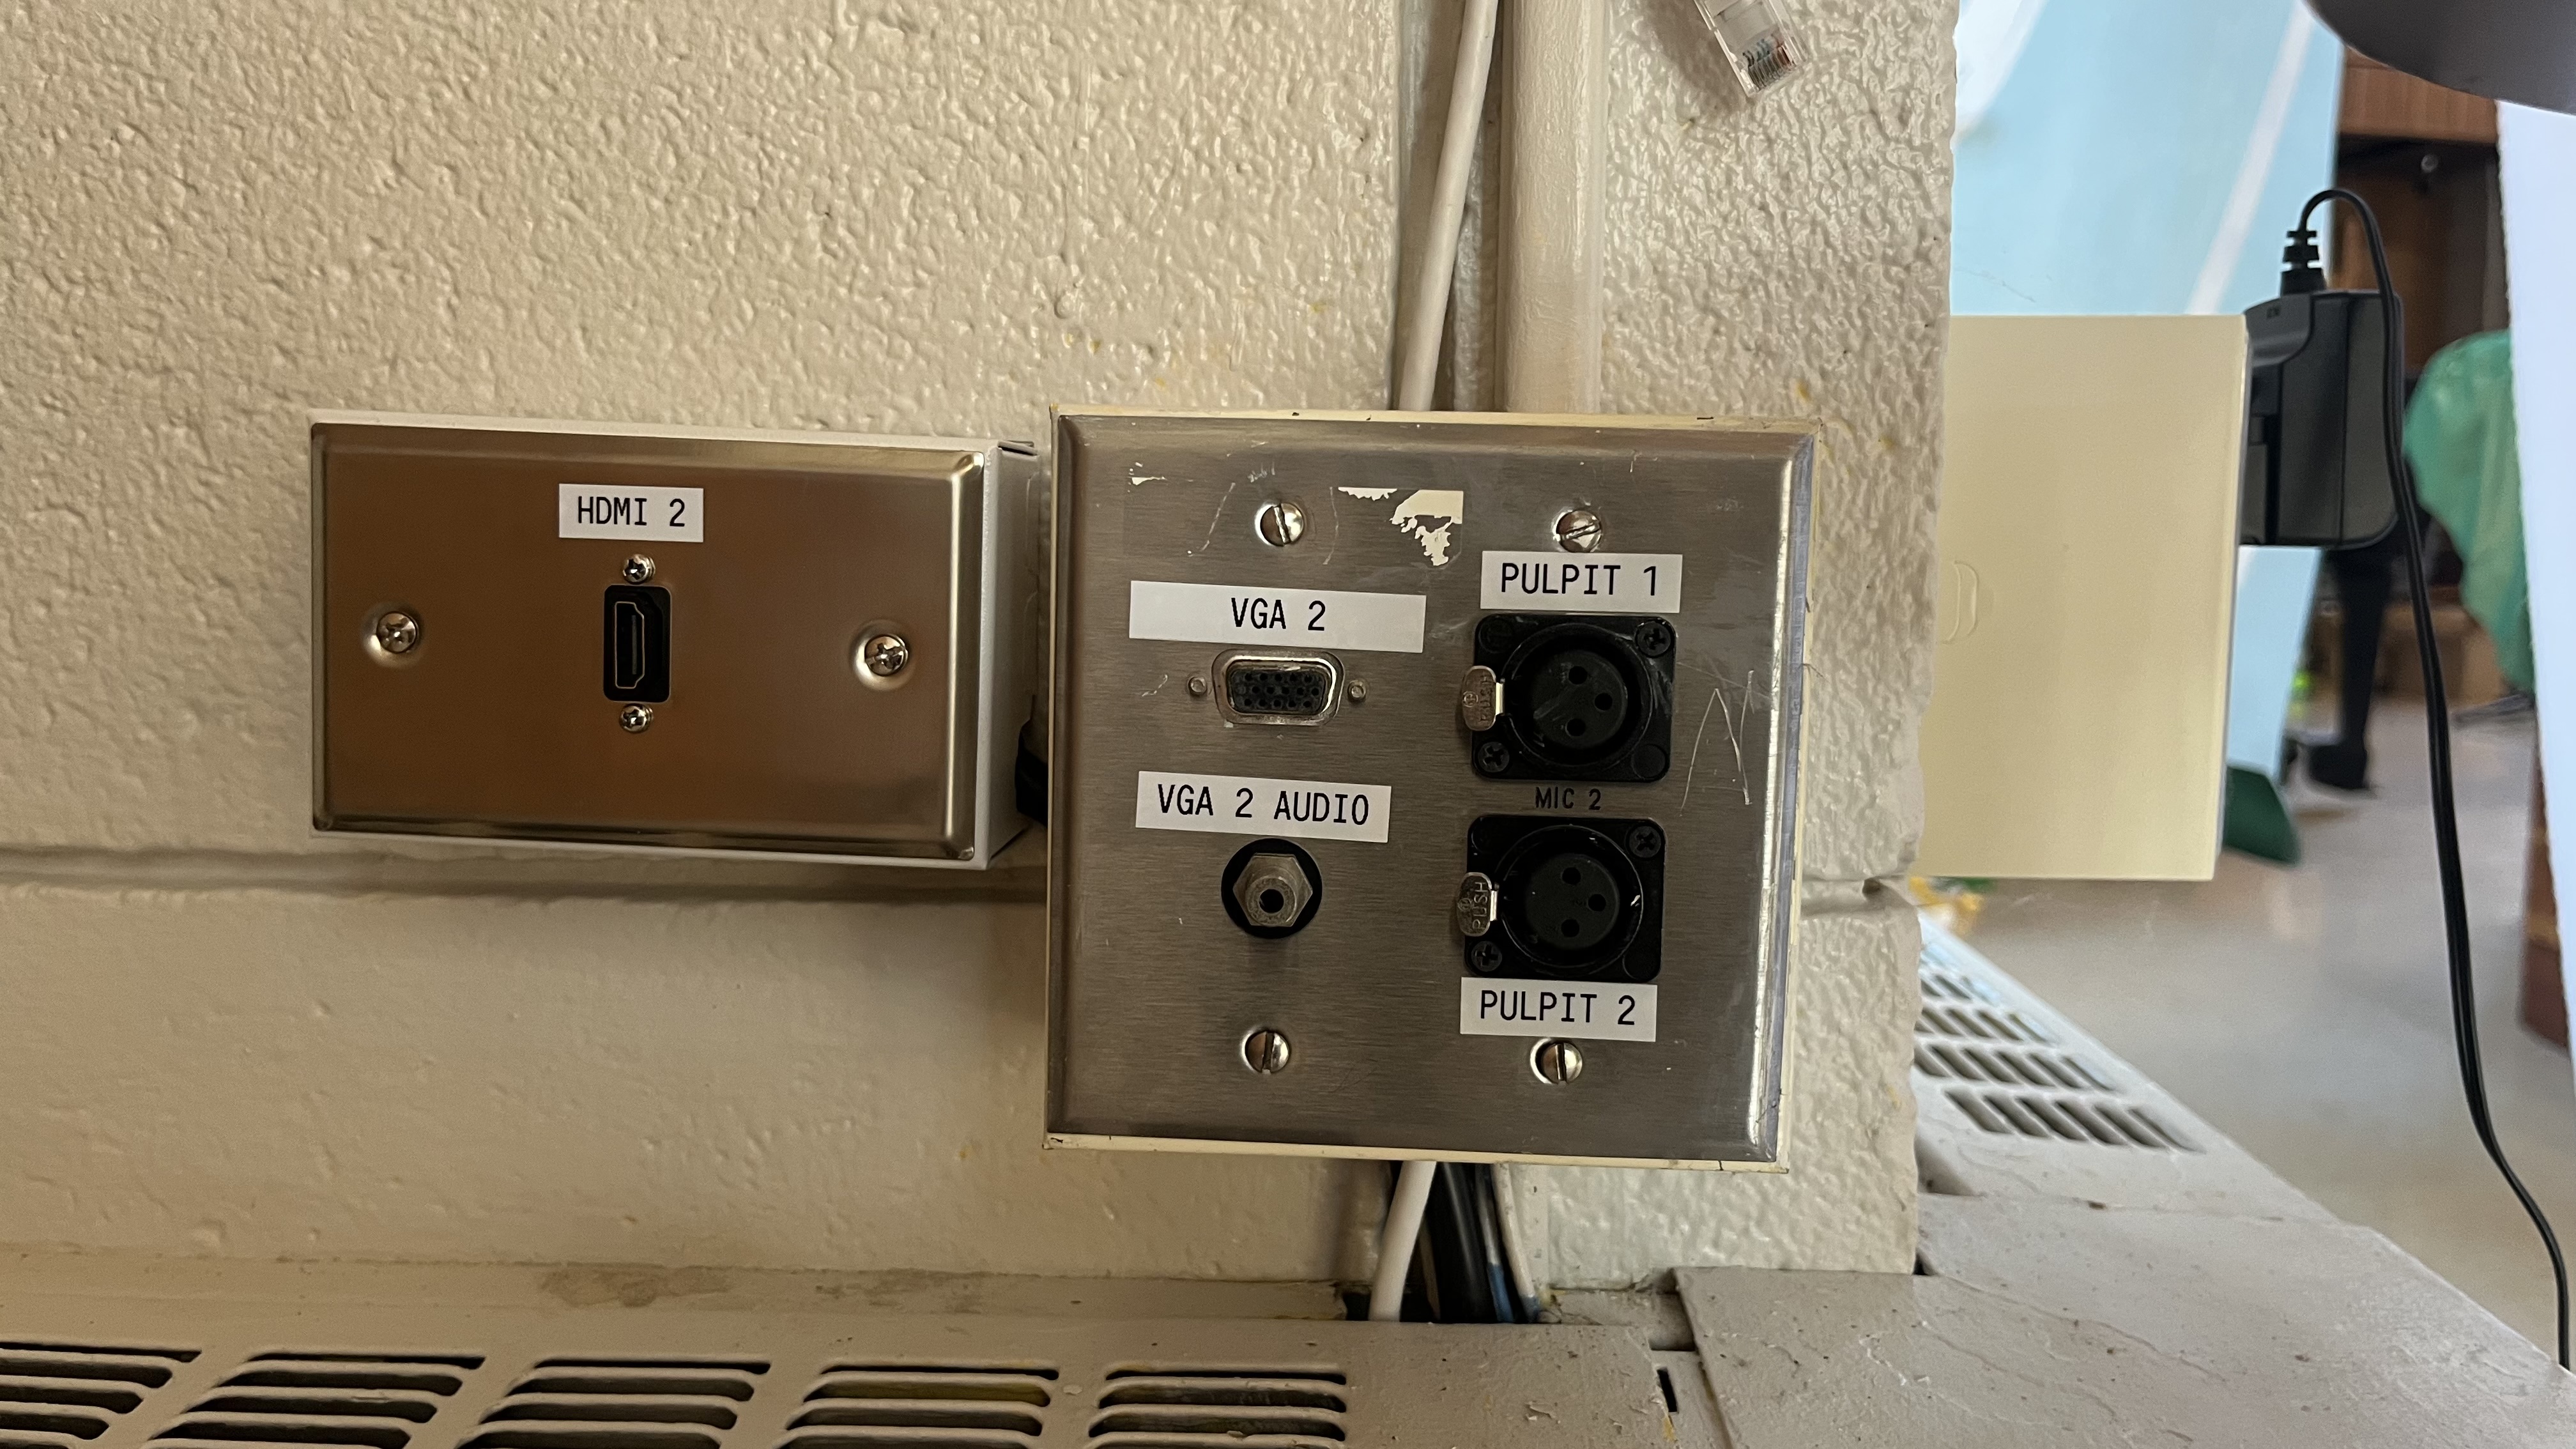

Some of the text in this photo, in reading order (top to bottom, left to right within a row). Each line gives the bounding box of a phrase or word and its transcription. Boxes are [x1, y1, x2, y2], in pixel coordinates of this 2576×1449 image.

[578, 496, 686, 527] HDMI 2
[1501, 562, 1656, 596] PULPIT 1
[1230, 597, 1326, 631] VGA 2
[1158, 783, 1369, 825] VGA 2 AUDIO
[1535, 786, 1601, 811] MIC 2
[1472, 882, 1488, 930] PUSH
[1480, 990, 1636, 1025] PULPIT 2
